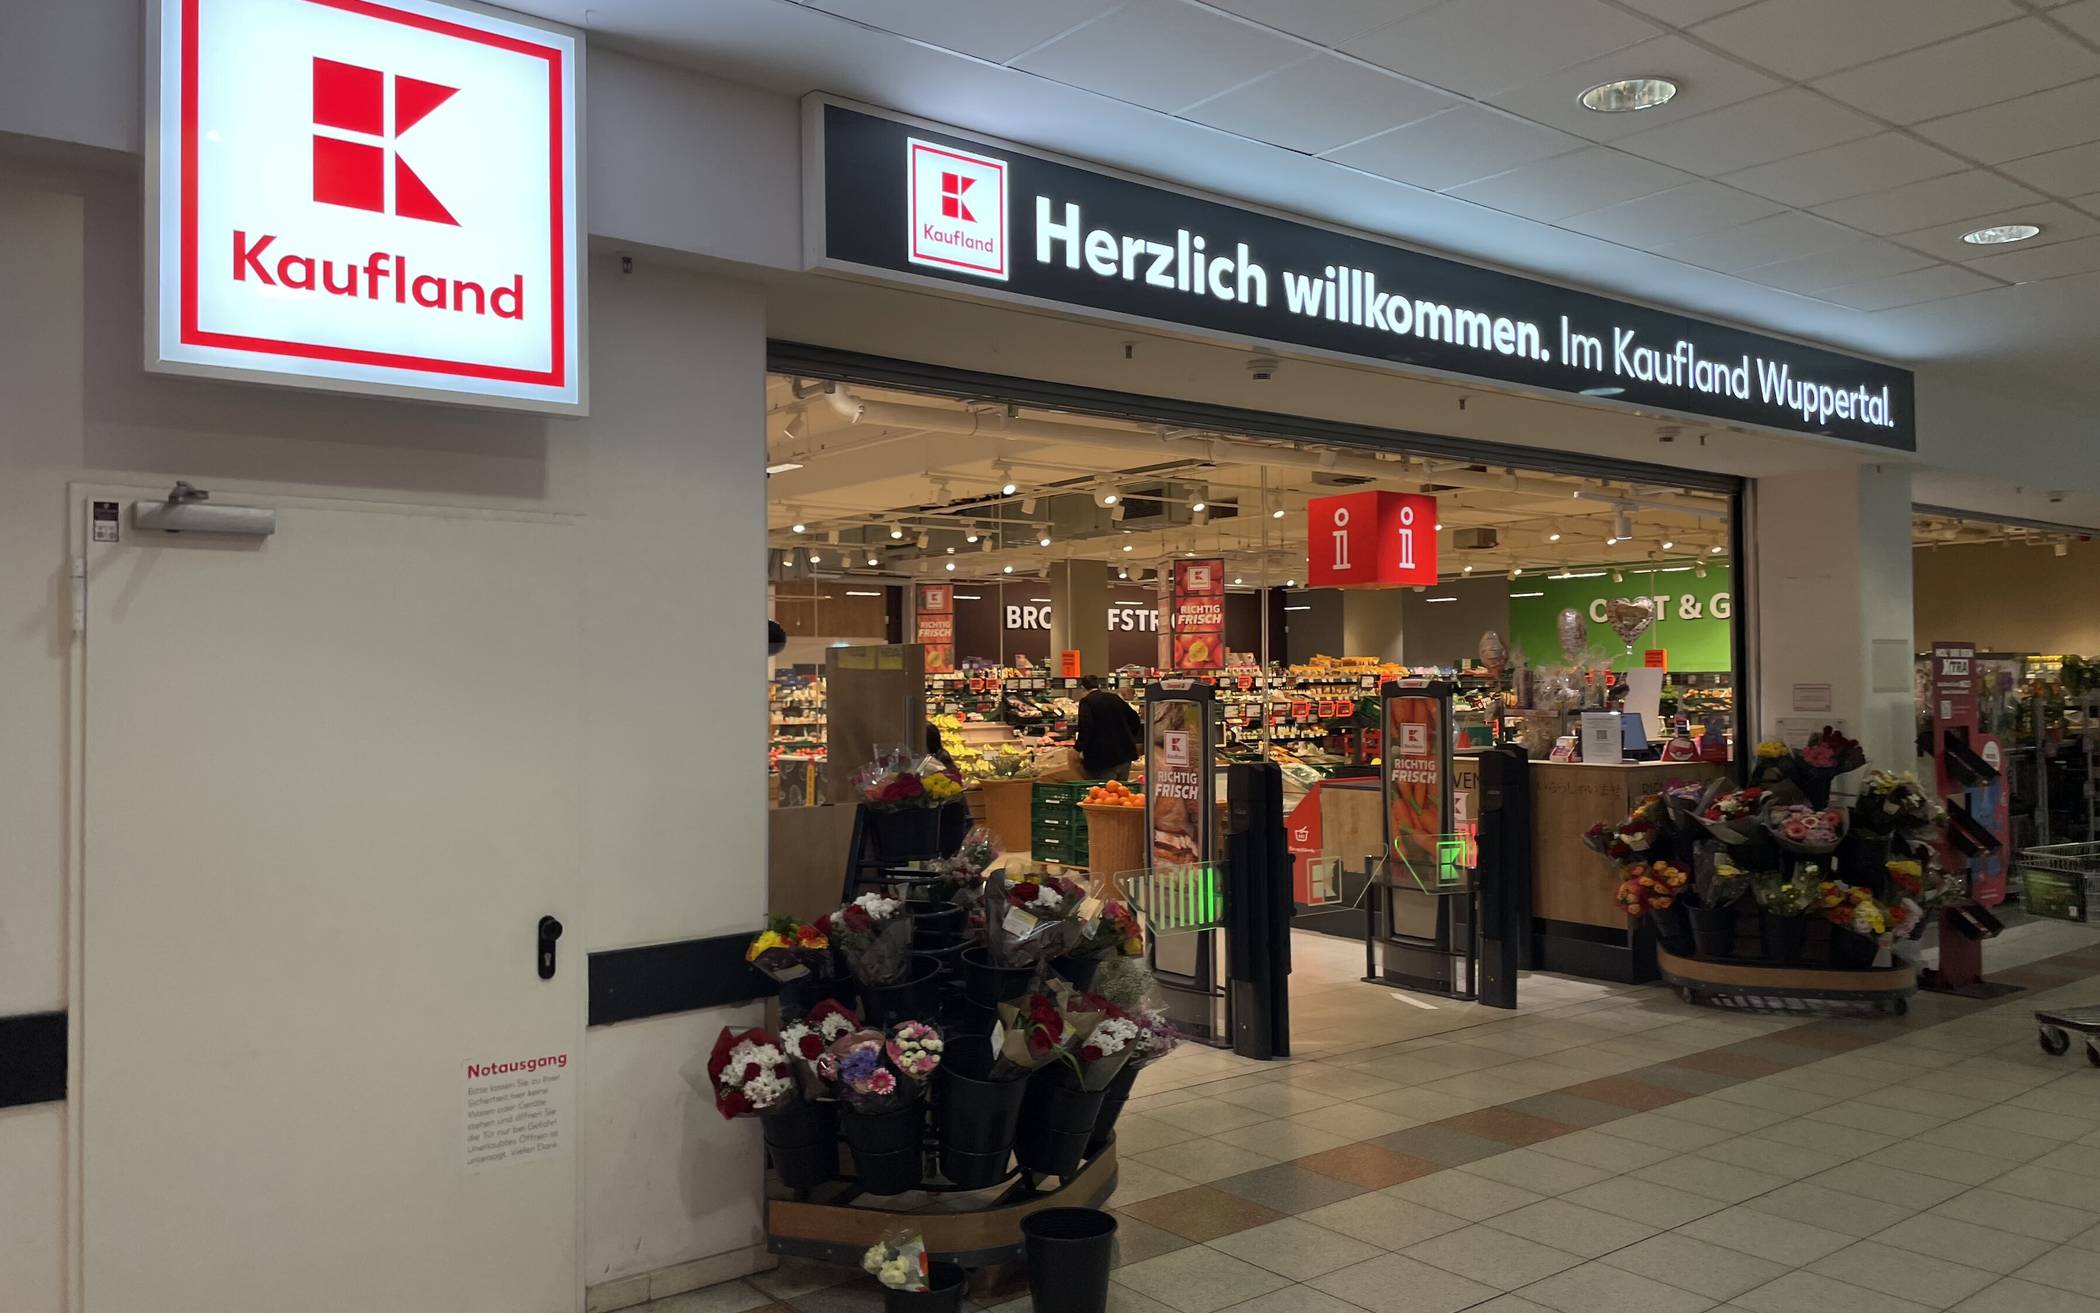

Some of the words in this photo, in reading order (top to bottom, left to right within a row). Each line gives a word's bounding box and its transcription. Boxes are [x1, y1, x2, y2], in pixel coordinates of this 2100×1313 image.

[924, 223, 994, 253] Kaufland
[232, 229, 525, 320] Kaufland
[1034, 195, 1268, 308] Herzlich
[1282, 264, 1550, 363] willkommen.
[1561, 315, 1602, 372] Im
[1613, 326, 1751, 400] Kaufland
[1756, 358, 1895, 428] Wuppertal.
[1180, 604, 1220, 614] RICHTIG
[1679, 594, 1702, 620] &
[1177, 613, 1222, 625] FRISCH
[918, 628, 952, 638] FRISCH
[1394, 758, 1436, 771] RICHTIG
[1157, 771, 1198, 784] RICHTIG
[1391, 769, 1437, 784] FRISCH
[1155, 784, 1199, 800] FRISCH
[467, 1054, 567, 1079] Notausgang
